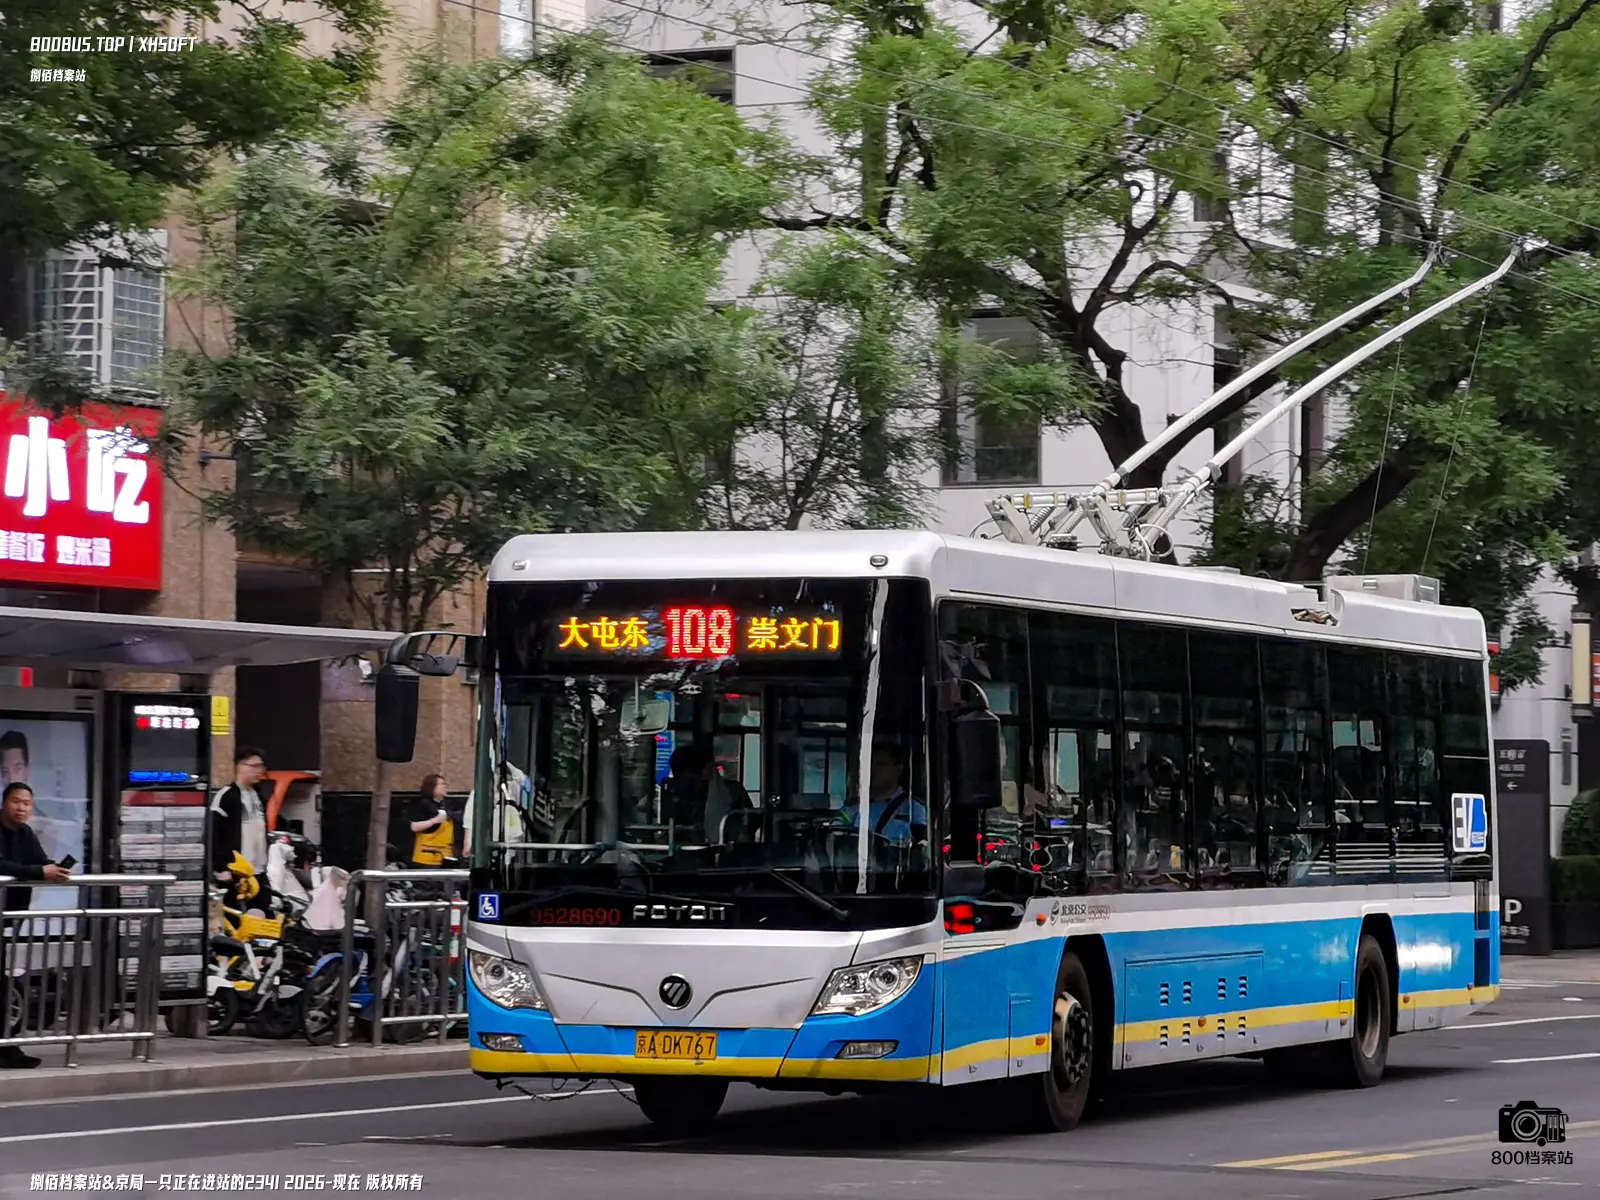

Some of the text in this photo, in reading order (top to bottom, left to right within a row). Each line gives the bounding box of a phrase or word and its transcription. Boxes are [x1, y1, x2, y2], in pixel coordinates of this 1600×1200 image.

[4, 415, 150, 525] 小吃
[558, 608, 840, 654] 大屯东 108 崇文门
[530, 907, 622, 926] 9528690
[632, 904, 726, 921] FOTON
[1504, 898, 1523, 923] P
